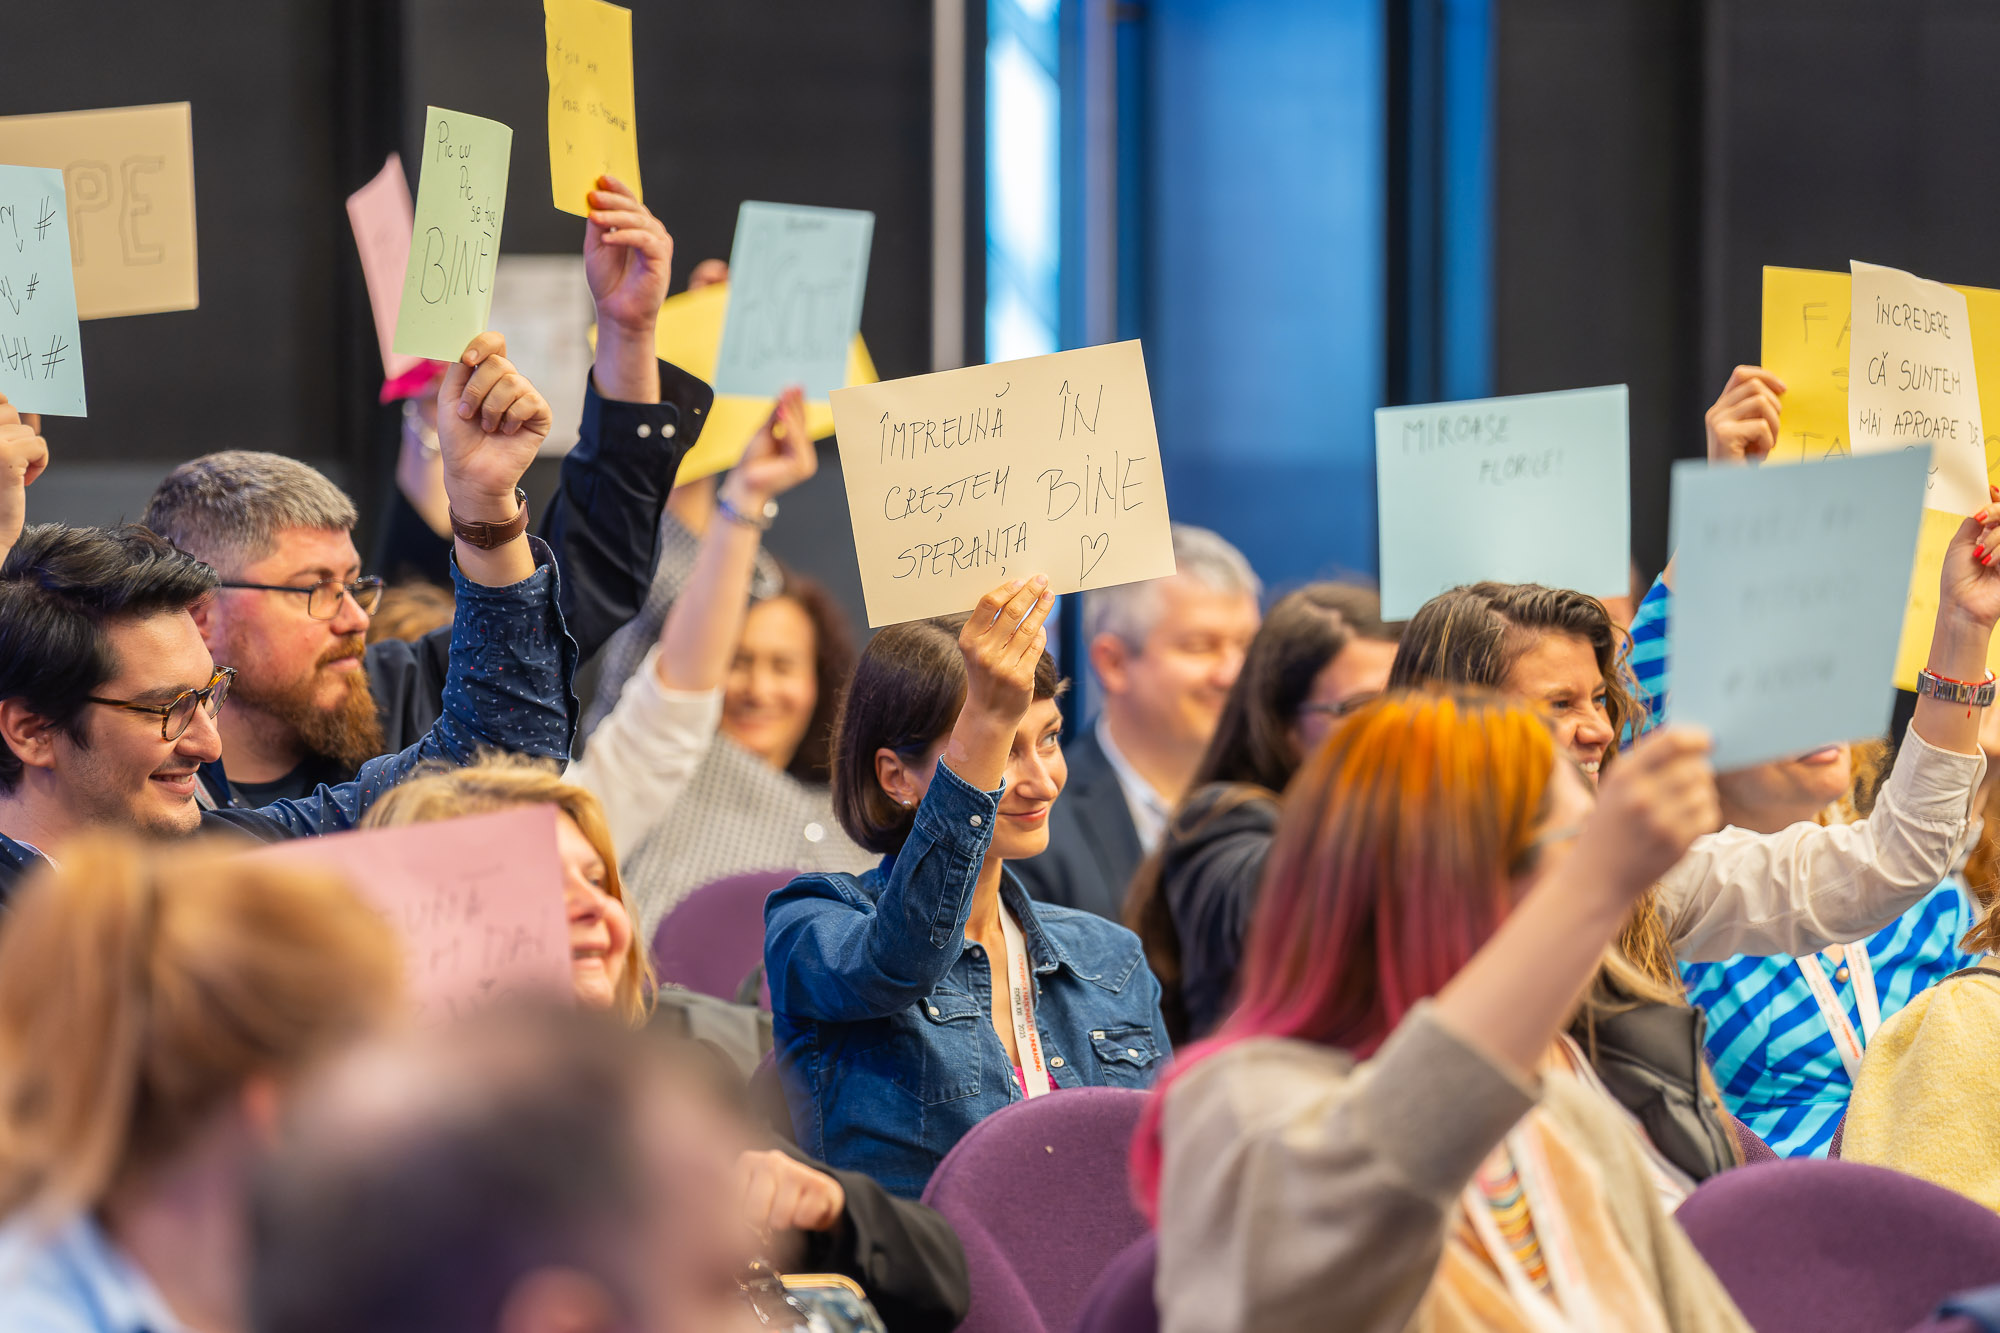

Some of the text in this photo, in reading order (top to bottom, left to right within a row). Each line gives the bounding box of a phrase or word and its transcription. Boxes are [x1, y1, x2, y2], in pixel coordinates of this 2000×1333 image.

[1876, 295, 1951, 340] ÎNCREDERE
[1867, 351, 1889, 387] CĂ
[1898, 359, 1961, 396] SUNTEM
[879, 380, 1103, 464] ÎMPREUNĂ ÎN
[1401, 412, 1512, 456] MIROASE
[1893, 410, 1959, 440] APROAPE
[884, 465, 1011, 522] CREȘTEM
[892, 521, 1028, 579] SPERANȚA
